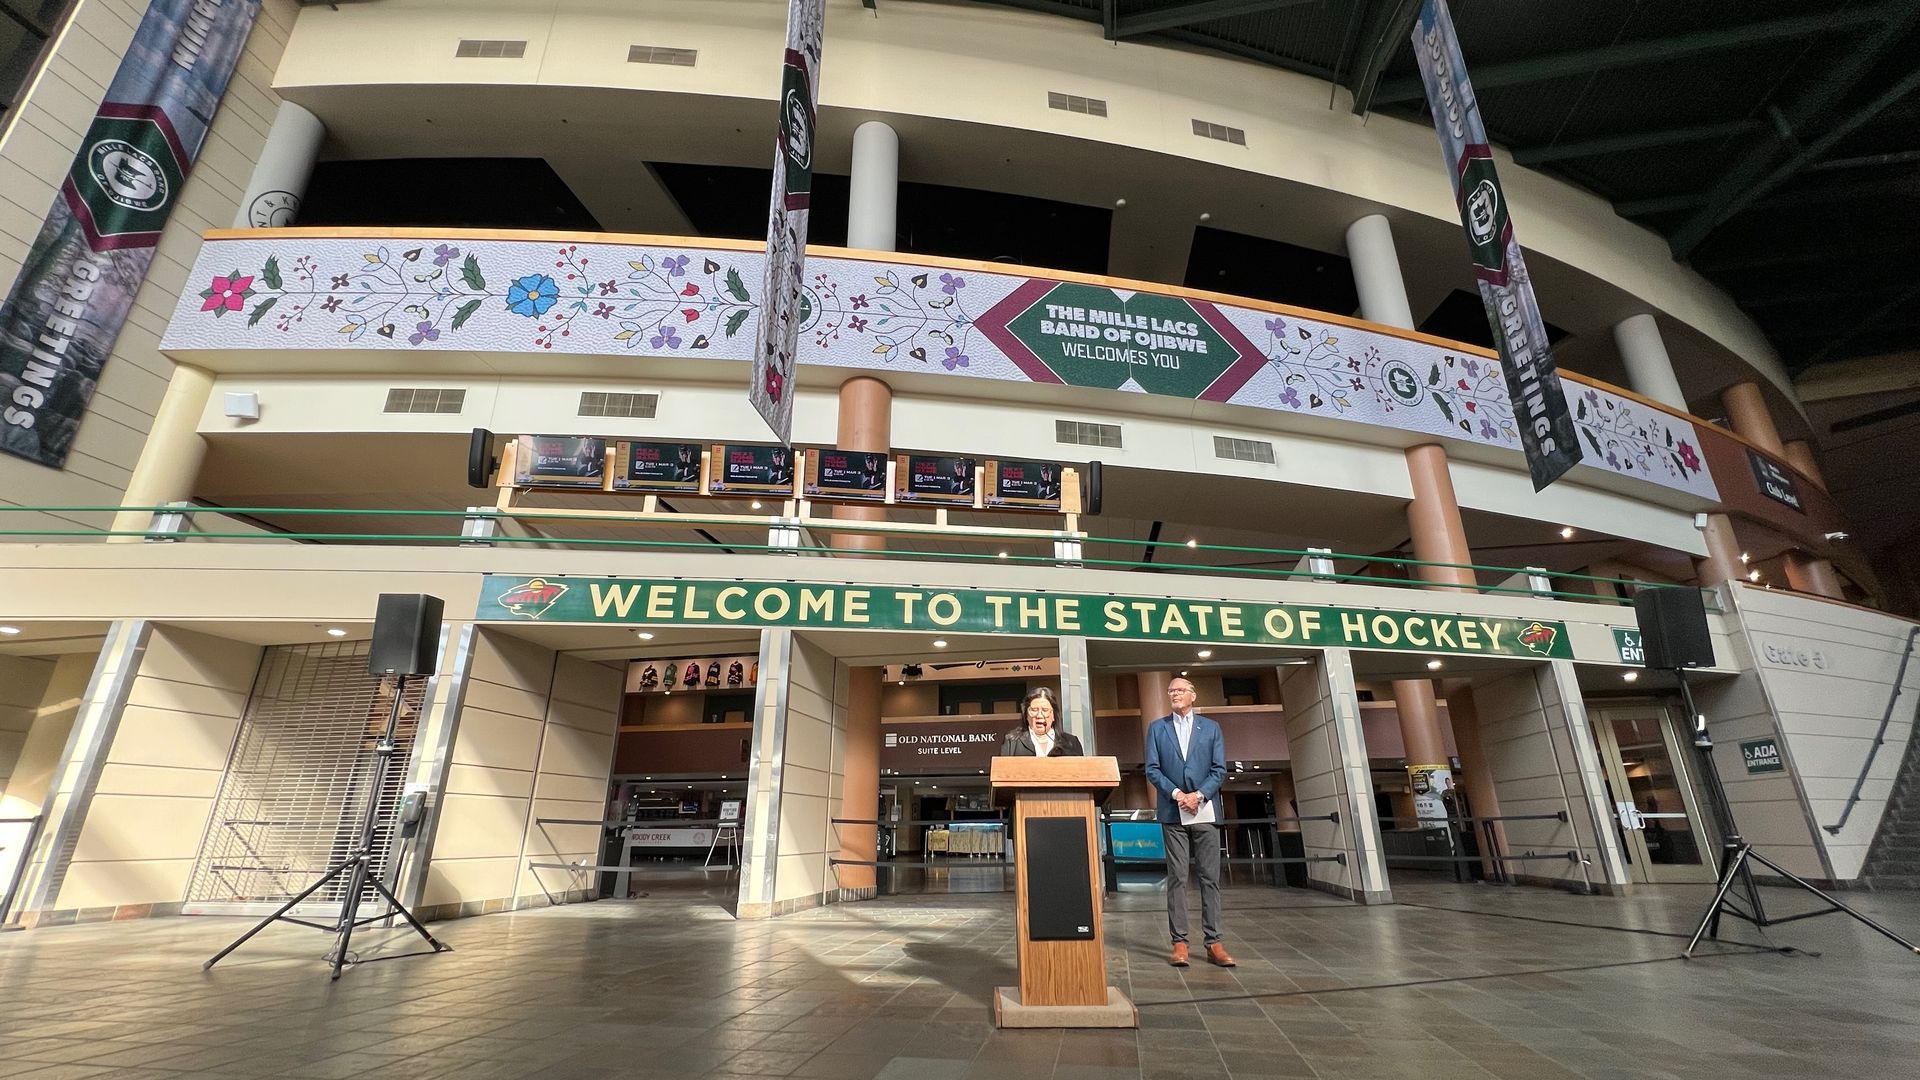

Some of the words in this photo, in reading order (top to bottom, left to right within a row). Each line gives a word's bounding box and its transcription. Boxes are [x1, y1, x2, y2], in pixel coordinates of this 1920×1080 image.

[169, 0, 222, 72] ANIIN
[1046, 304, 1086, 322] THE
[1089, 309, 1149, 331] MILLE
[1150, 317, 1199, 337] LACS
[3, 260, 100, 430] GREETINGS
[1040, 319, 1100, 340] BAND
[1103, 327, 1132, 344] OF
[1134, 331, 1208, 355] OJIBWE
[1062, 341, 1148, 366] WELCOMES
[1150, 352, 1180, 370] YOU
[1500, 295, 1556, 457] GREETINGS
[590, 583, 871, 623] WELCOME
[895, 591, 962, 626] TO
[985, 595, 1081, 631] THE
[1103, 600, 1245, 638] STATE
[1264, 608, 1321, 640] OF
[1340, 612, 1502, 651] HOCKEY
[898, 735, 918, 744] OLD
[920, 733, 968, 744] NATIONAL
[968, 732, 995, 743] BANK
[918, 747, 939, 755] SUITE
[940, 747, 962, 755] LEVEL
[1754, 744, 1778, 759] ADA
[1747, 756, 1781, 767] ENTRANCE
[651, 833, 671, 841] CREEK
